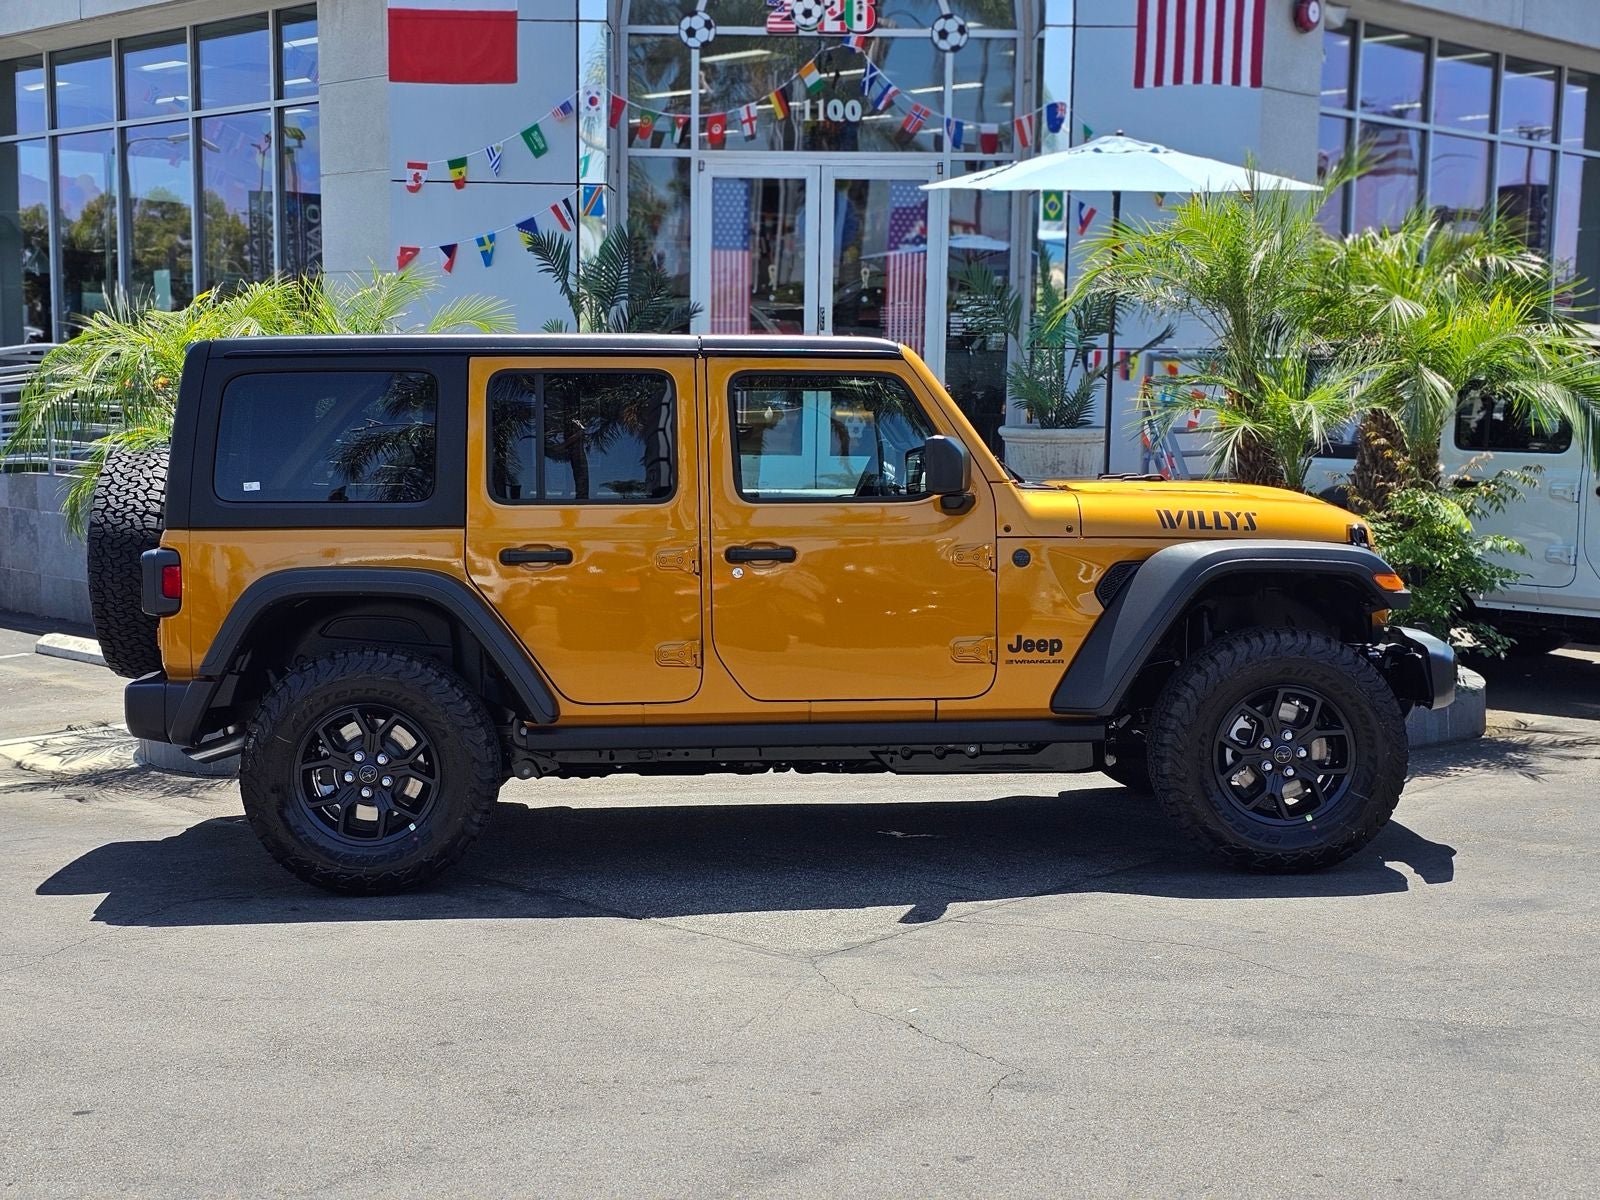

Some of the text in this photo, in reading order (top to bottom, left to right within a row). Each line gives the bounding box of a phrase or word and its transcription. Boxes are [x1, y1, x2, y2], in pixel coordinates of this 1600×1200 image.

[803, 98, 862, 122] 1100
[1156, 509, 1257, 531] WILLYS
[1008, 635, 1063, 656] Jeep
